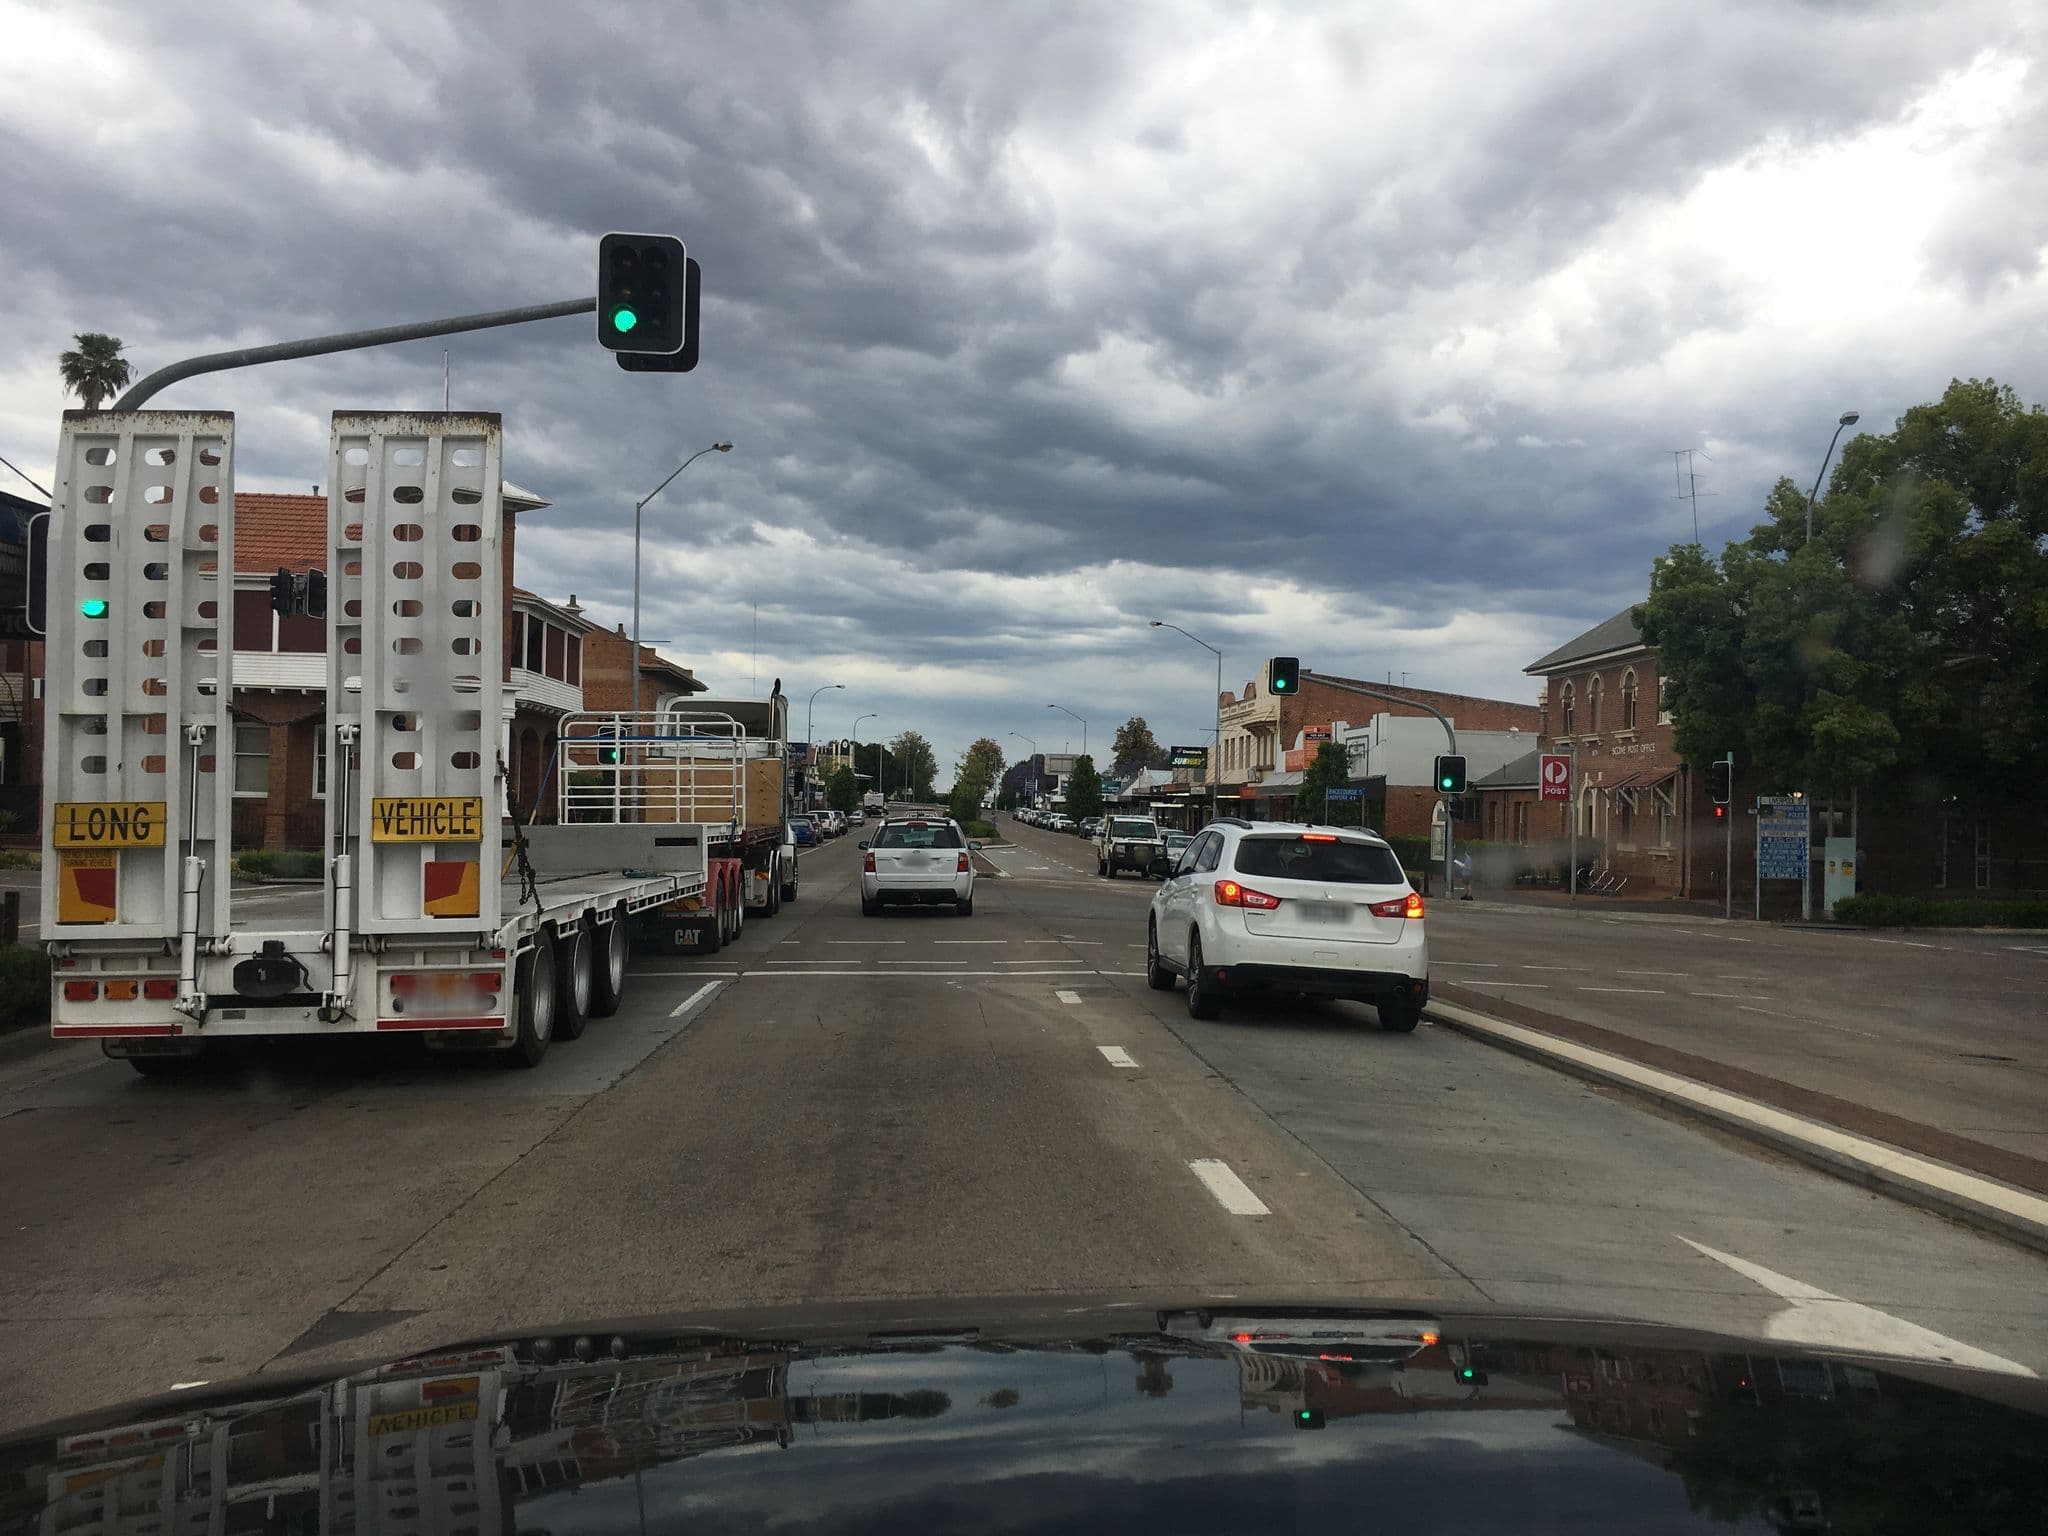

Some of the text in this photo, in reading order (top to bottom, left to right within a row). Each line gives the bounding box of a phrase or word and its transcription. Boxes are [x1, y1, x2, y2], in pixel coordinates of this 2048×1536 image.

[1171, 757, 1201, 765] SUBWAY
[1544, 787, 1567, 795] POST
[70, 806, 150, 841] LONG
[380, 801, 475, 835] VEHICLE
[674, 929, 701, 945] CAT
